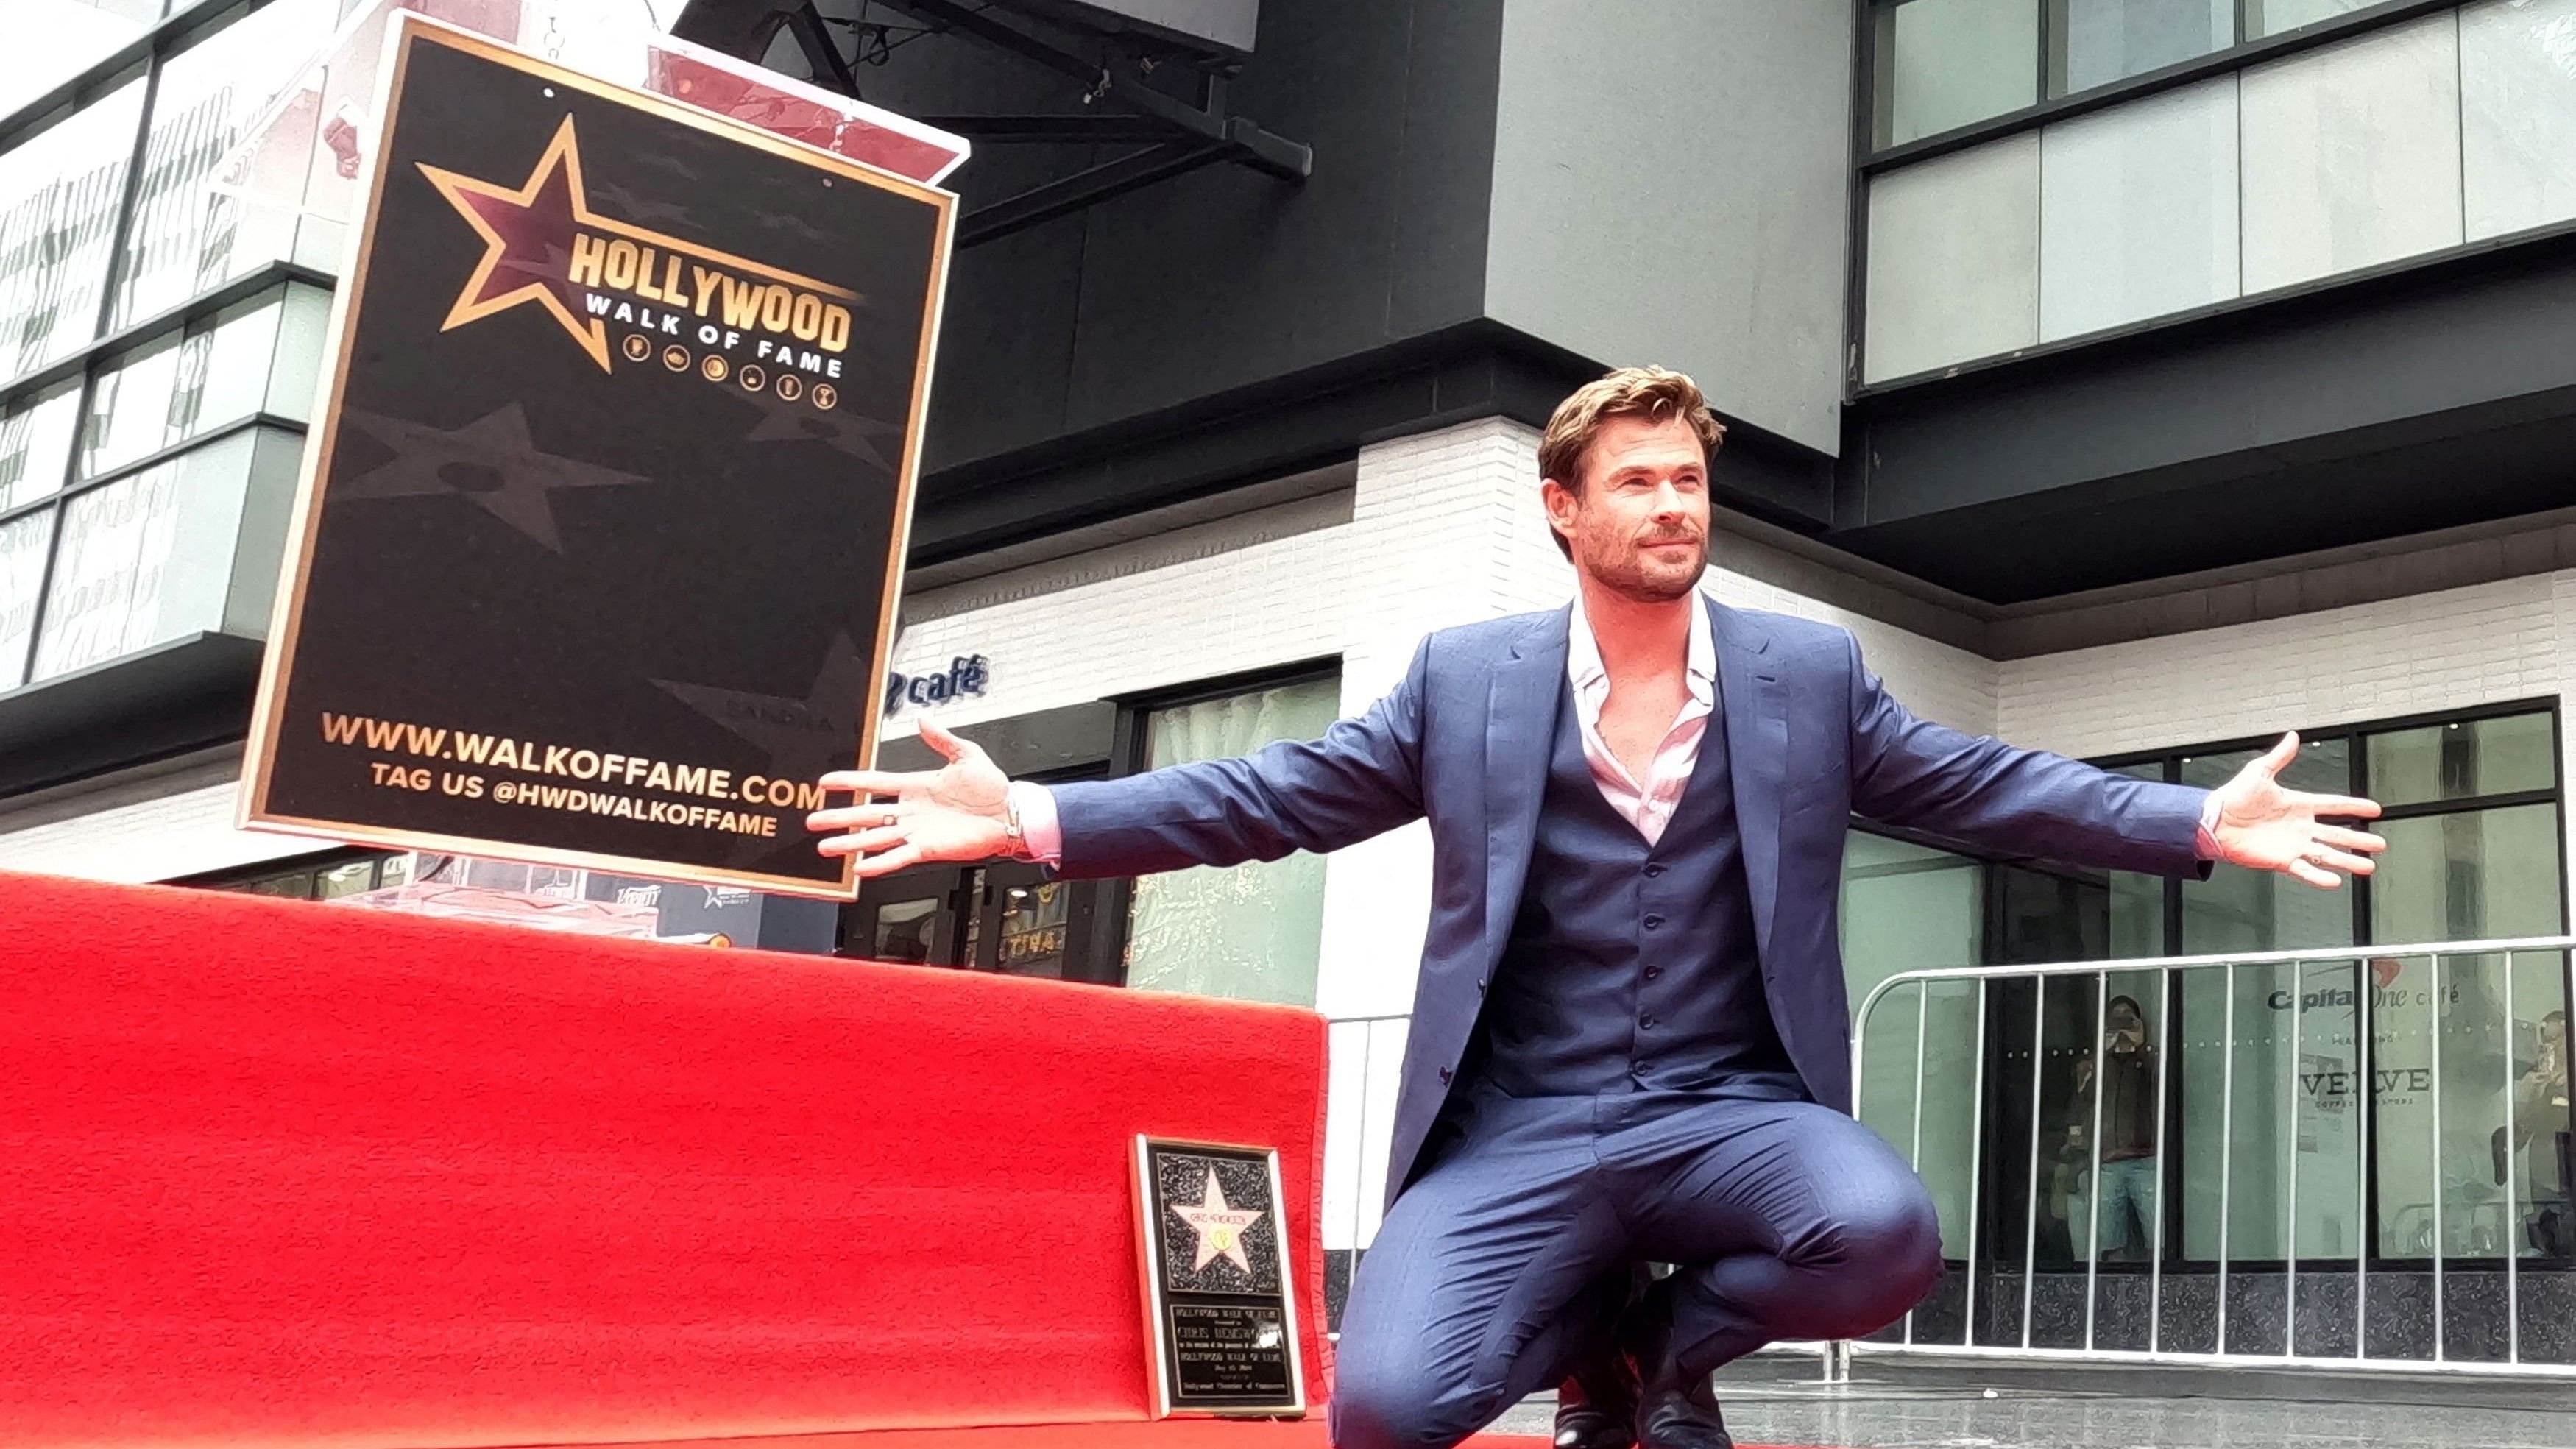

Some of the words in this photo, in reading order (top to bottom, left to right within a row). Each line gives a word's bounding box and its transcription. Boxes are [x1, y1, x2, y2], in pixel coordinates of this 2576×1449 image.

[568, 233, 852, 352] HOLLYWOOD
[586, 293, 681, 336] WALK
[698, 325, 740, 350] OF
[757, 340, 843, 378] FAME
[908, 653, 988, 706] café
[322, 712, 827, 811] WWW.WALKOFFAME.COM
[371, 762, 432, 791] TAG
[442, 773, 485, 798] US
[493, 782, 778, 837] @HWDWALKOFFAME
[2268, 988, 2353, 1013] Cpita
[2416, 984, 2459, 1007] cfé
[2300, 1068, 2430, 1095] VEVE
